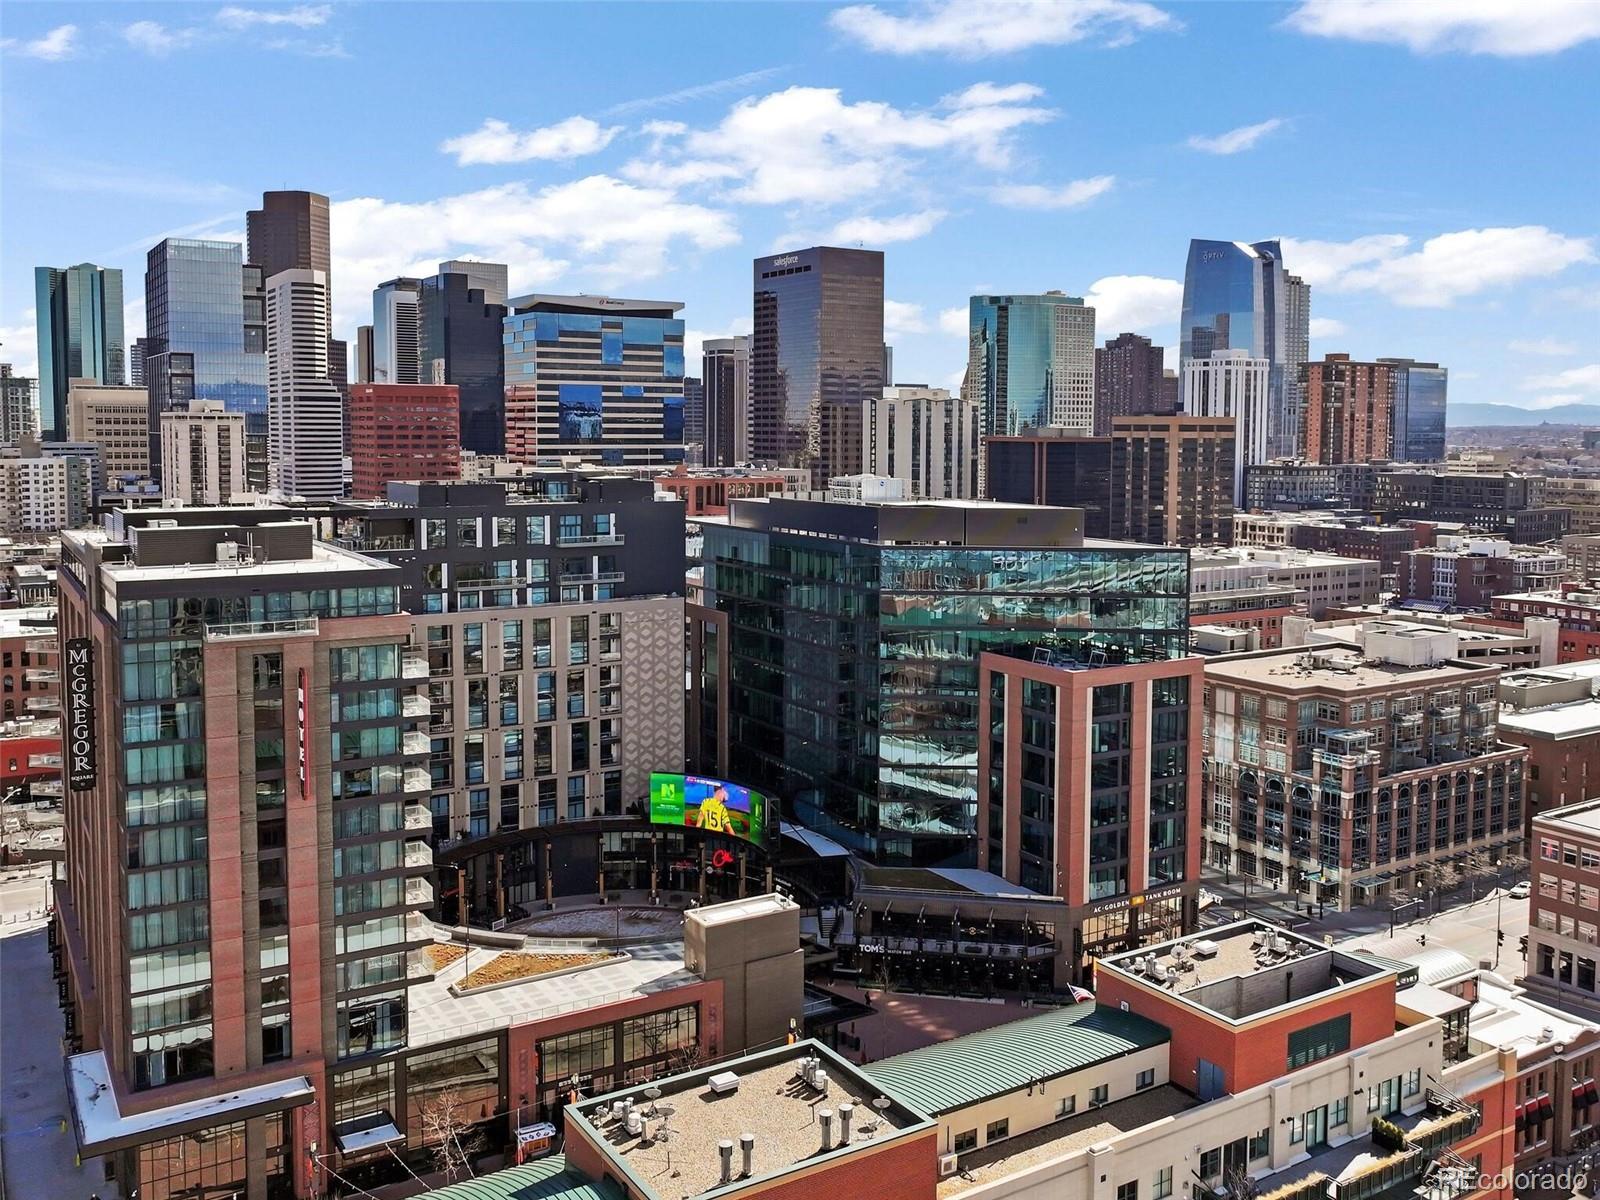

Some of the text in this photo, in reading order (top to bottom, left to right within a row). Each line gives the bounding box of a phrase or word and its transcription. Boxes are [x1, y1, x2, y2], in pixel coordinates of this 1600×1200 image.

[774, 255, 799, 267] salesforce
[71, 774, 94, 782] SQUARE
[706, 809, 718, 828] 15
[1145, 887, 1181, 901] TANK ROOM
[858, 943, 885, 954] TOM'S
